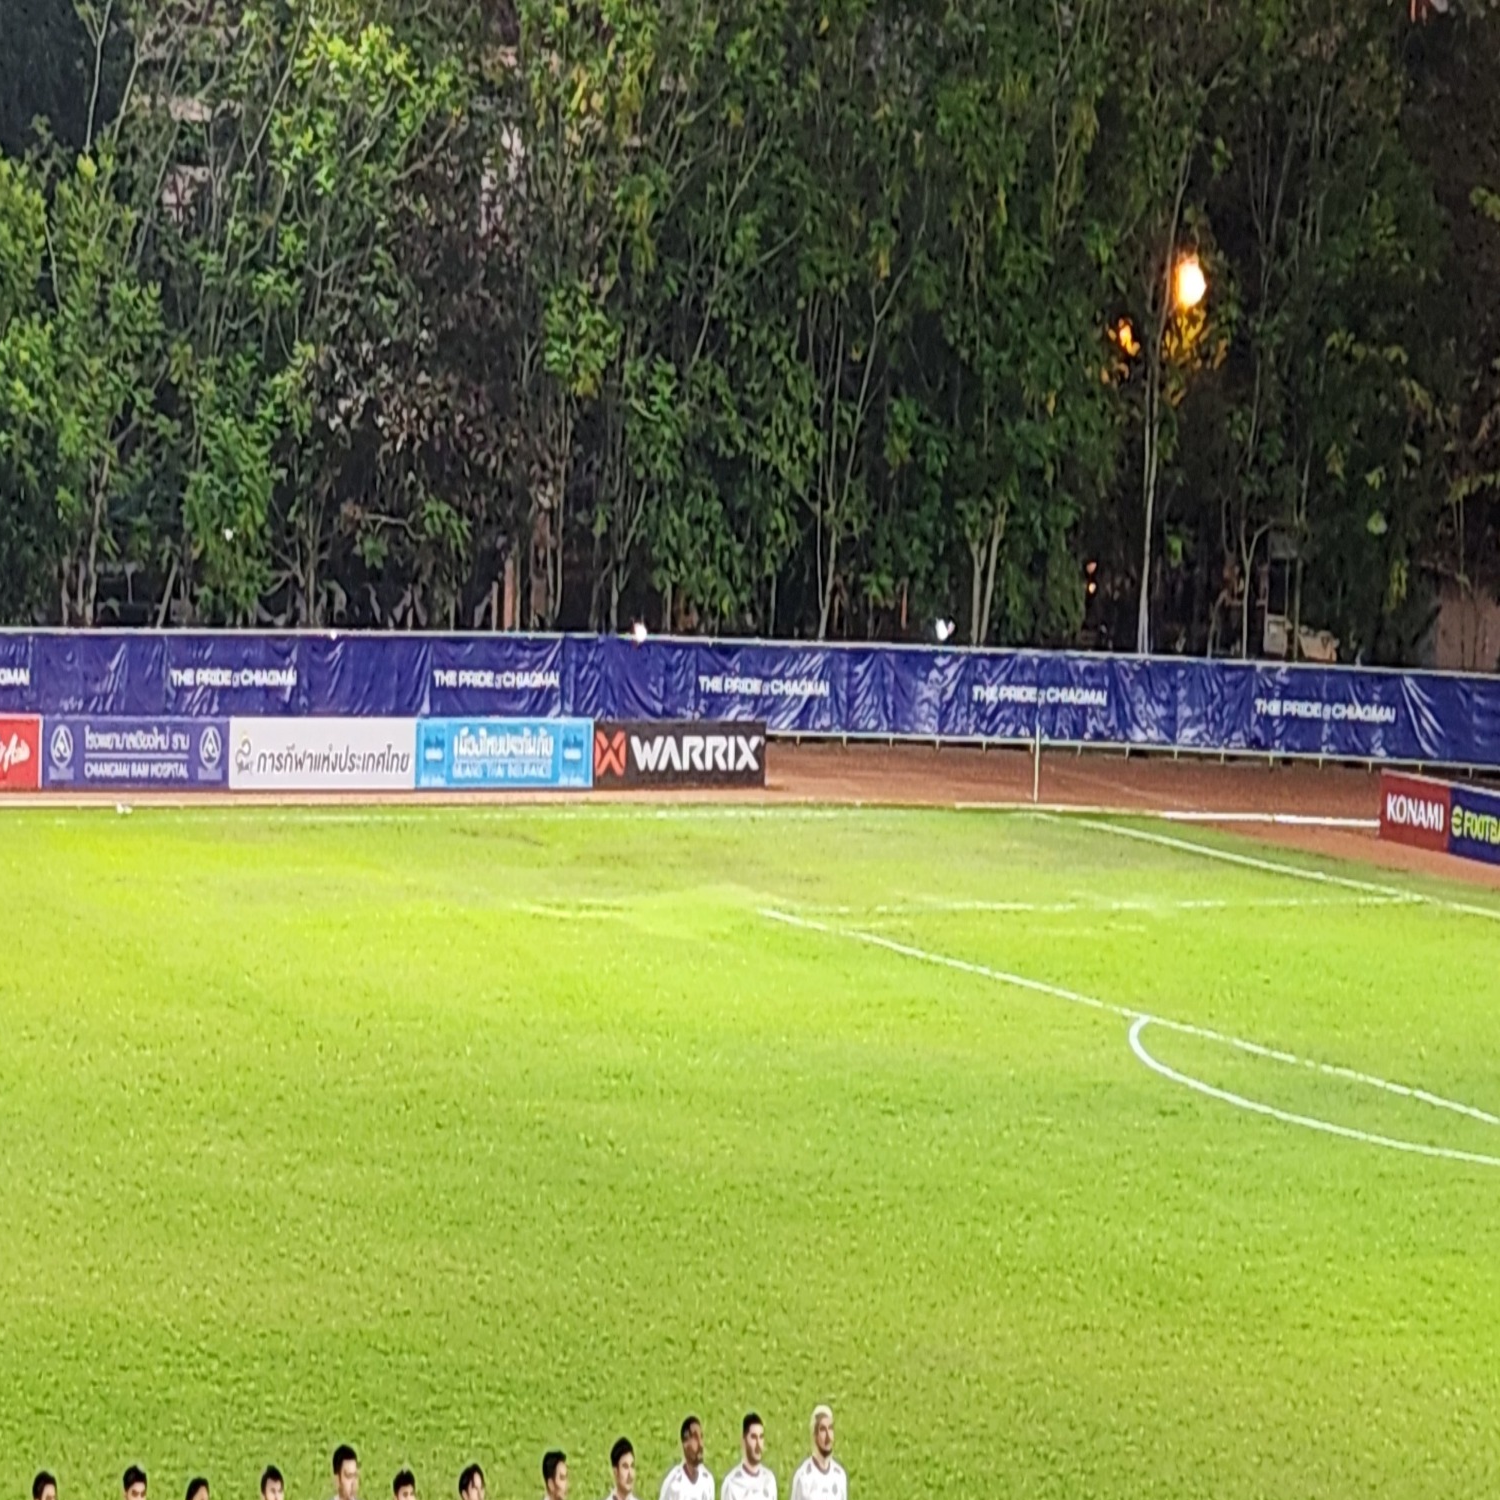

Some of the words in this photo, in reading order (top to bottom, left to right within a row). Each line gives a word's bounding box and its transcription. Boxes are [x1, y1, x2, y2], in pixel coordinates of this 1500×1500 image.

[169, 668, 195, 687] THE
[195, 667, 232, 687] PRIDE
[433, 669, 457, 688] THE
[458, 669, 494, 689] PRIDE
[698, 675, 723, 694] THE
[724, 676, 762, 695] PRIDE
[972, 685, 999, 703] THE
[999, 685, 1037, 703] PRIDE
[1254, 698, 1281, 716] THE
[1283, 699, 1322, 718] PRIDE
[256, 743, 411, 773] การกีฬาแห่งประเทศไทย
[630, 735, 760, 771] WARRIX
[1386, 792, 1444, 833] KONAMI
